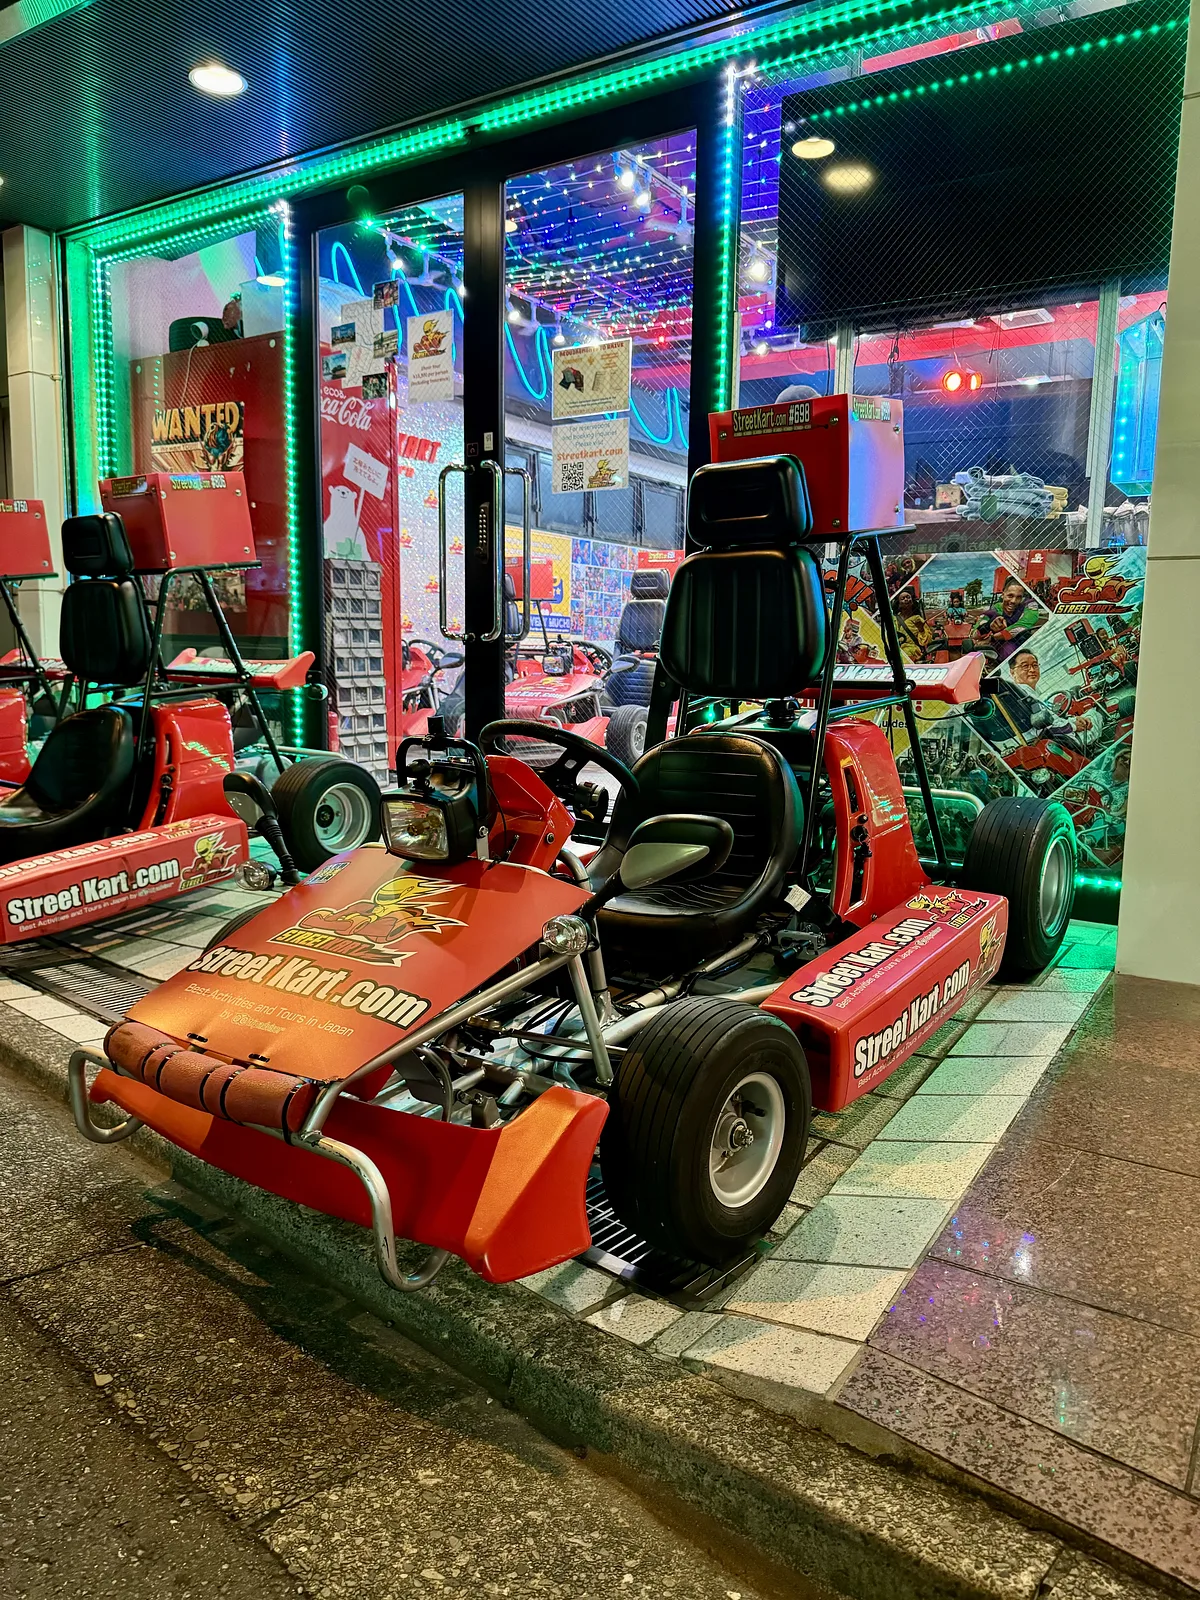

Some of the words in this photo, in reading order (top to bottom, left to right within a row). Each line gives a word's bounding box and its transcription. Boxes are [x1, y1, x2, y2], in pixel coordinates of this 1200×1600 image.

[152, 401, 240, 442] WANTED
[320, 396, 375, 431] ca-Cola
[733, 408, 787, 432] StreetKart.com
[788, 402, 810, 426] #698
[1056, 604, 1090, 614] STREET
[7, 885, 82, 925] Street
[19, 922, 36, 933] Best
[277, 930, 336, 948] STREET
[189, 946, 284, 984] Street
[792, 962, 869, 1007] Street
[184, 983, 210, 997] Best
[208, 988, 256, 1009] Activities
[254, 1002, 278, 1015] and
[276, 1007, 307, 1024] Tours
[306, 1015, 319, 1027] in
[318, 1019, 354, 1037] Japan
[219, 1008, 233, 1020] by
[855, 1010, 909, 1078] Street
